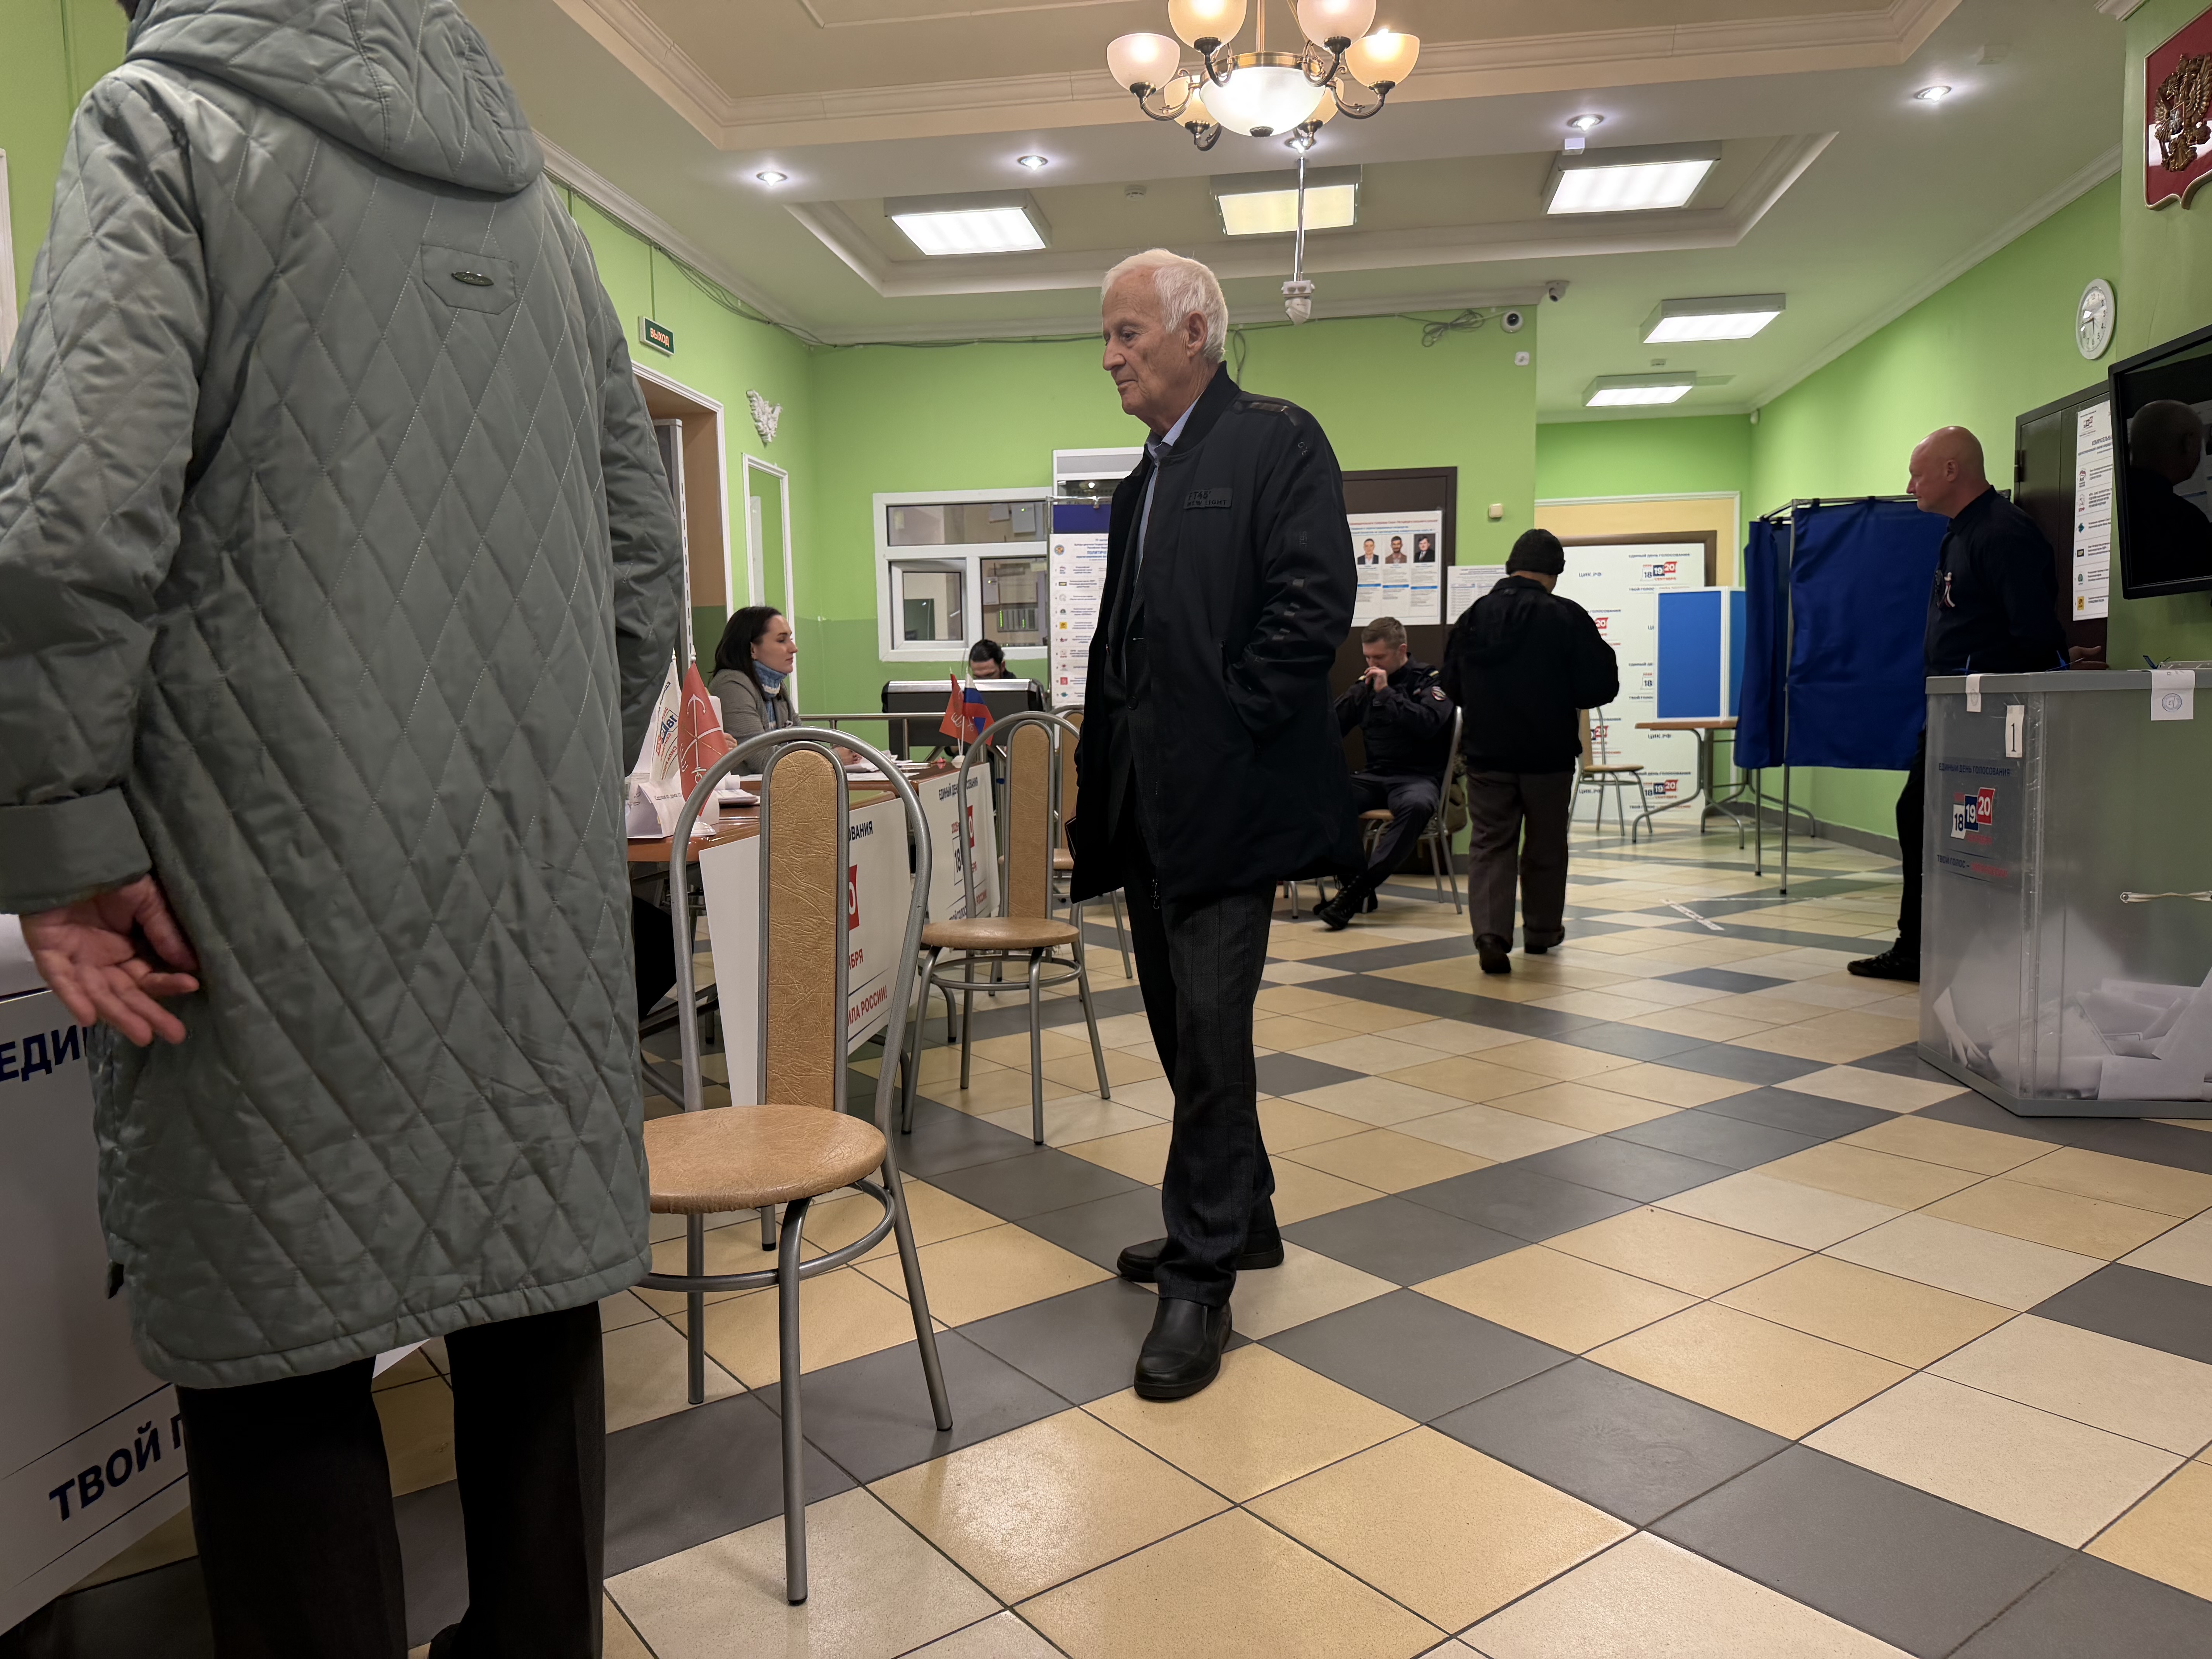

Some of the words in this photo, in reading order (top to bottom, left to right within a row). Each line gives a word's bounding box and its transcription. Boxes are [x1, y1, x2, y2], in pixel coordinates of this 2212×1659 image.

[650, 327, 670, 347] ВЫХОД
[2011, 723, 2016, 752] 1
[1959, 764, 1972, 773] ДЕНЬ
[1973, 766, 2010, 777] ГОЛОСОВАНИЯ
[1966, 804, 1976, 823] 19
[1978, 796, 1991, 816] 20
[1954, 813, 1963, 831] 18
[955, 848, 961, 872] 18
[1949, 858, 1965, 868] ГОЛОС
[860, 985, 888, 1016] РОССИИ!
[0, 1025, 87, 1082] ЕДИ
[49, 1420, 161, 1521] ТВОЙ
